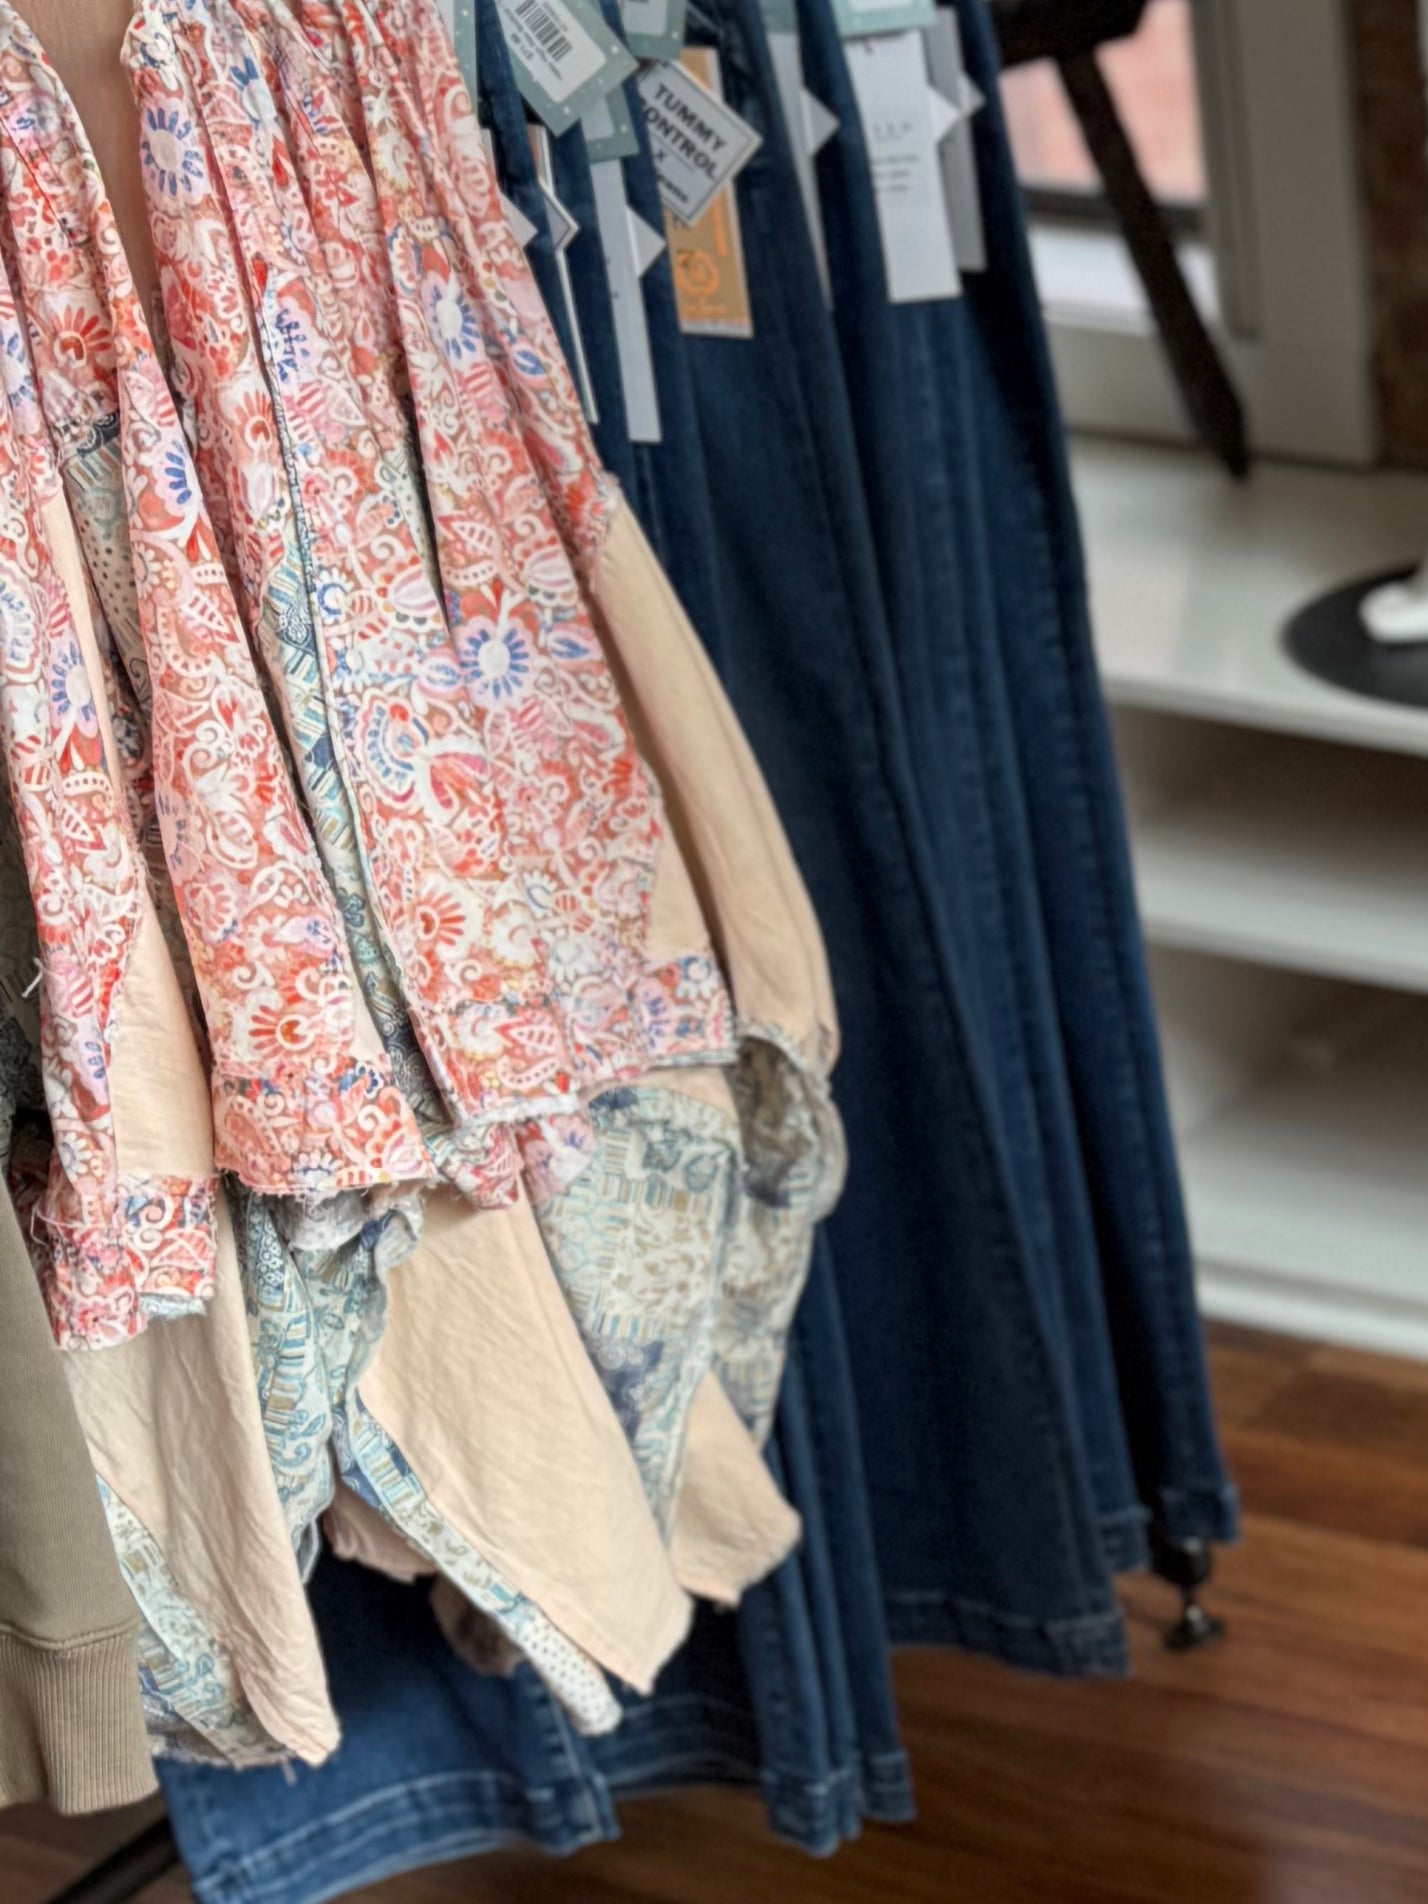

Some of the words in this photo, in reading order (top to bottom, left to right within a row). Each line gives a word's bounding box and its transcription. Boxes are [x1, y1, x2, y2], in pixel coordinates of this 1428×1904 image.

[640, 99, 717, 179] ONTROL
[655, 83, 727, 152] TUMMY
[657, 175, 689, 203] eans
